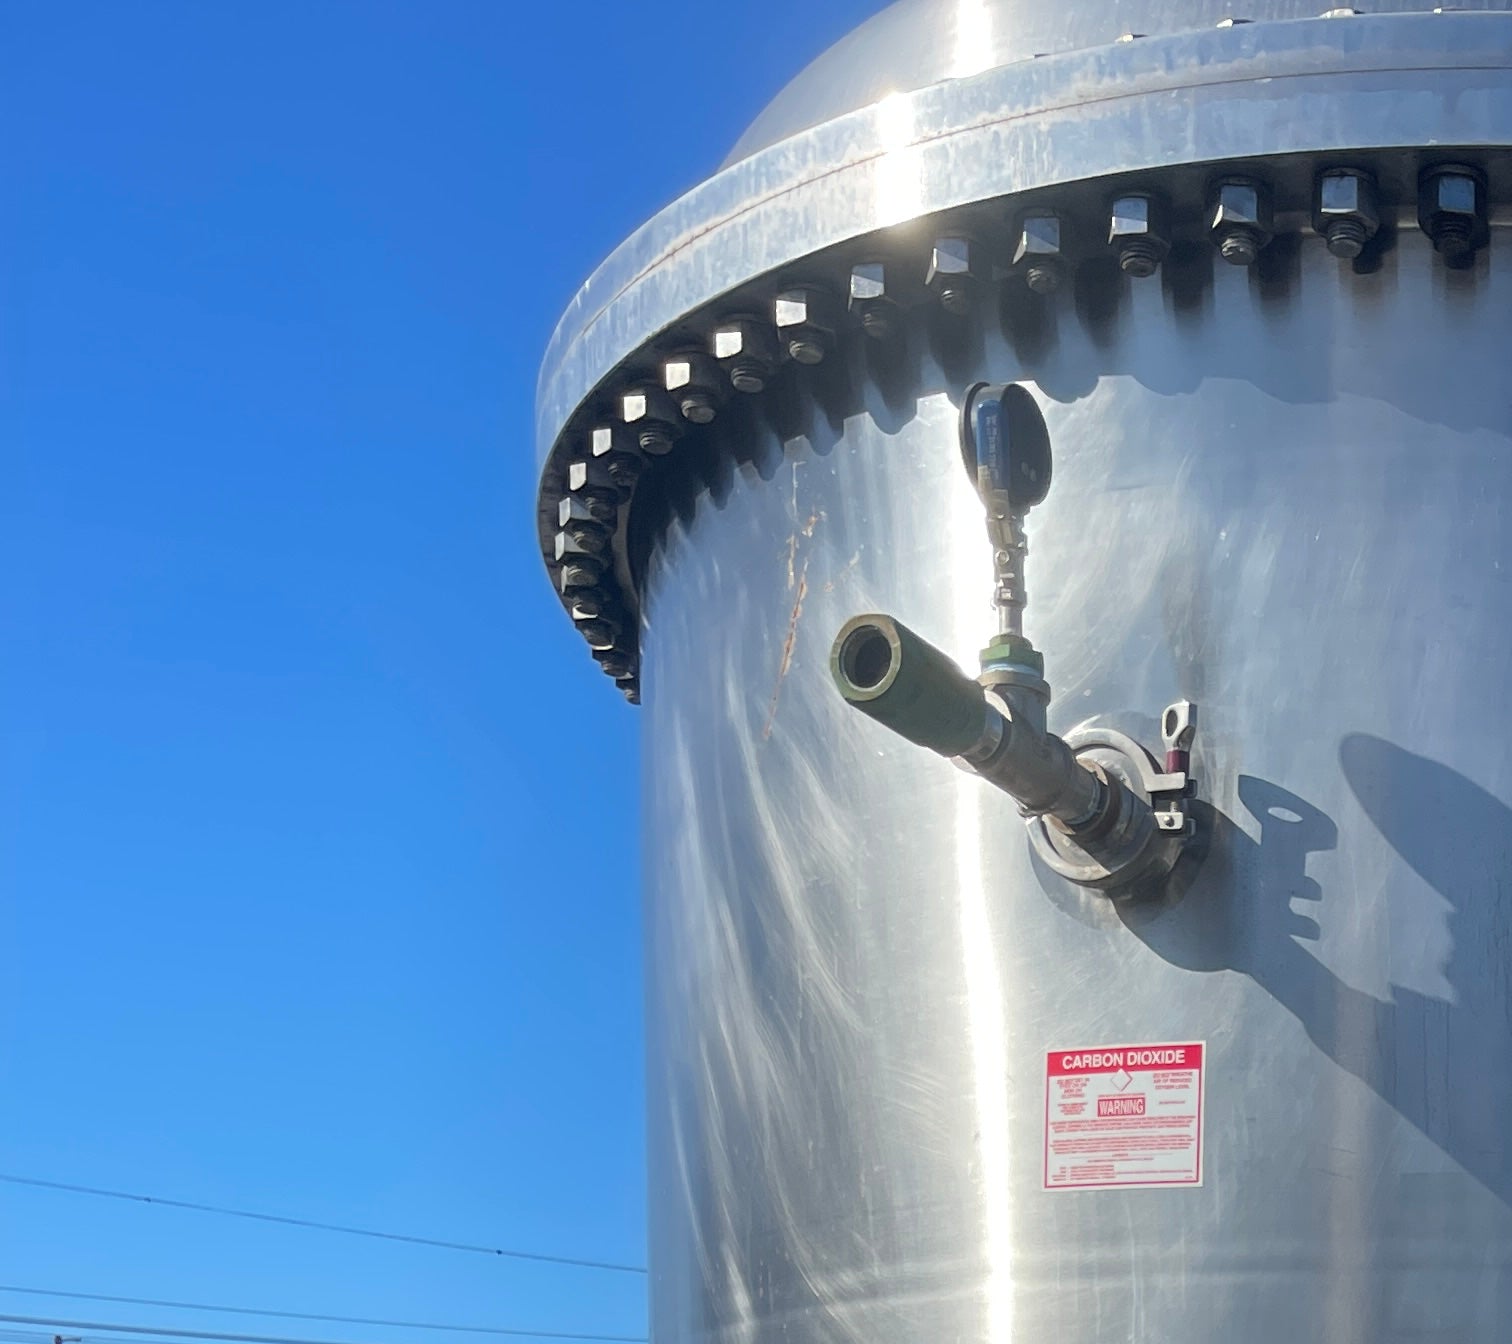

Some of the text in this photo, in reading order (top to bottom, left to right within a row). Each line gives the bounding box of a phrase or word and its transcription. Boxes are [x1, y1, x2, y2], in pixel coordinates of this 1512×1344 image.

[1062, 1049, 1186, 1070] CARBON DIOXIDE
[1099, 1099, 1144, 1116] WARNING
